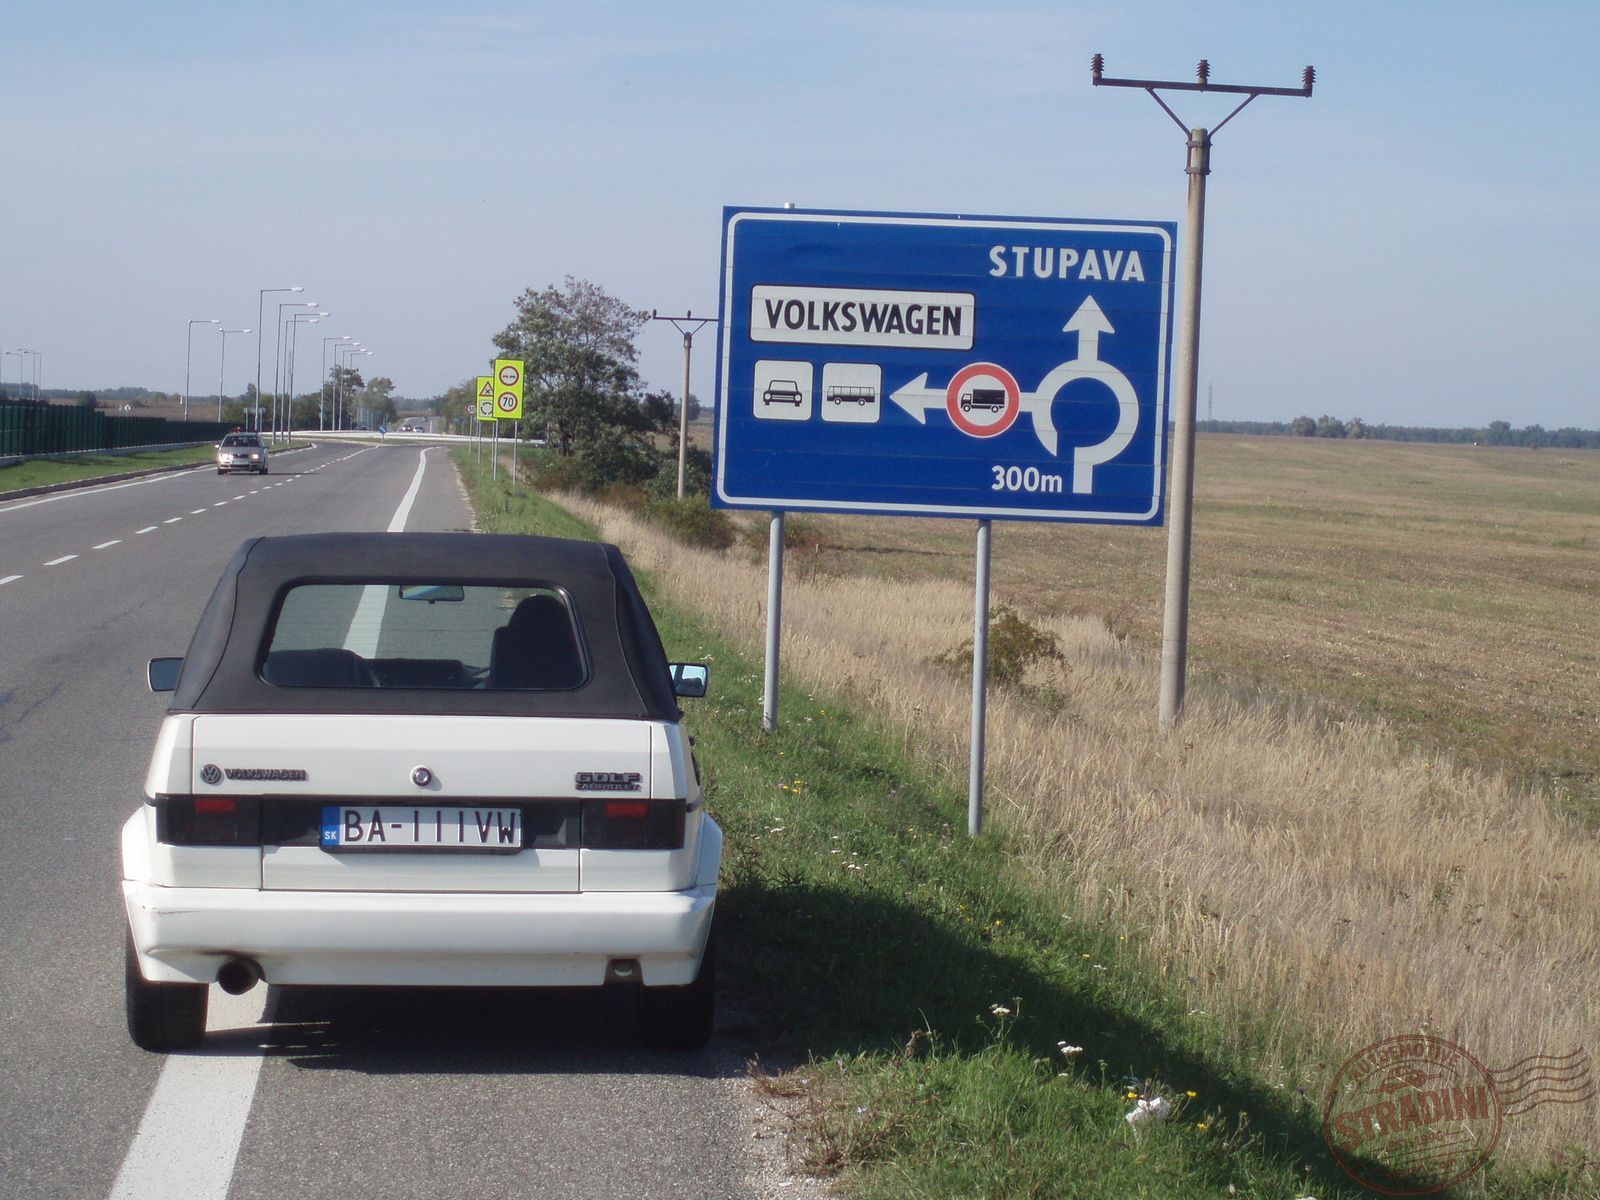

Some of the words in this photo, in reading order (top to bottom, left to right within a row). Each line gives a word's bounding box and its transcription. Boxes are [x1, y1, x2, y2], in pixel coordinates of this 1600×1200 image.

[989, 245, 1146, 282] STUPAVA
[764, 299, 962, 336] VOLKSWAGEN
[503, 397, 514, 407] 70
[991, 465, 1063, 493] 300m
[224, 768, 307, 781] VOLKSWAGEN
[575, 772, 641, 784] GOLF
[323, 831, 337, 840] SK
